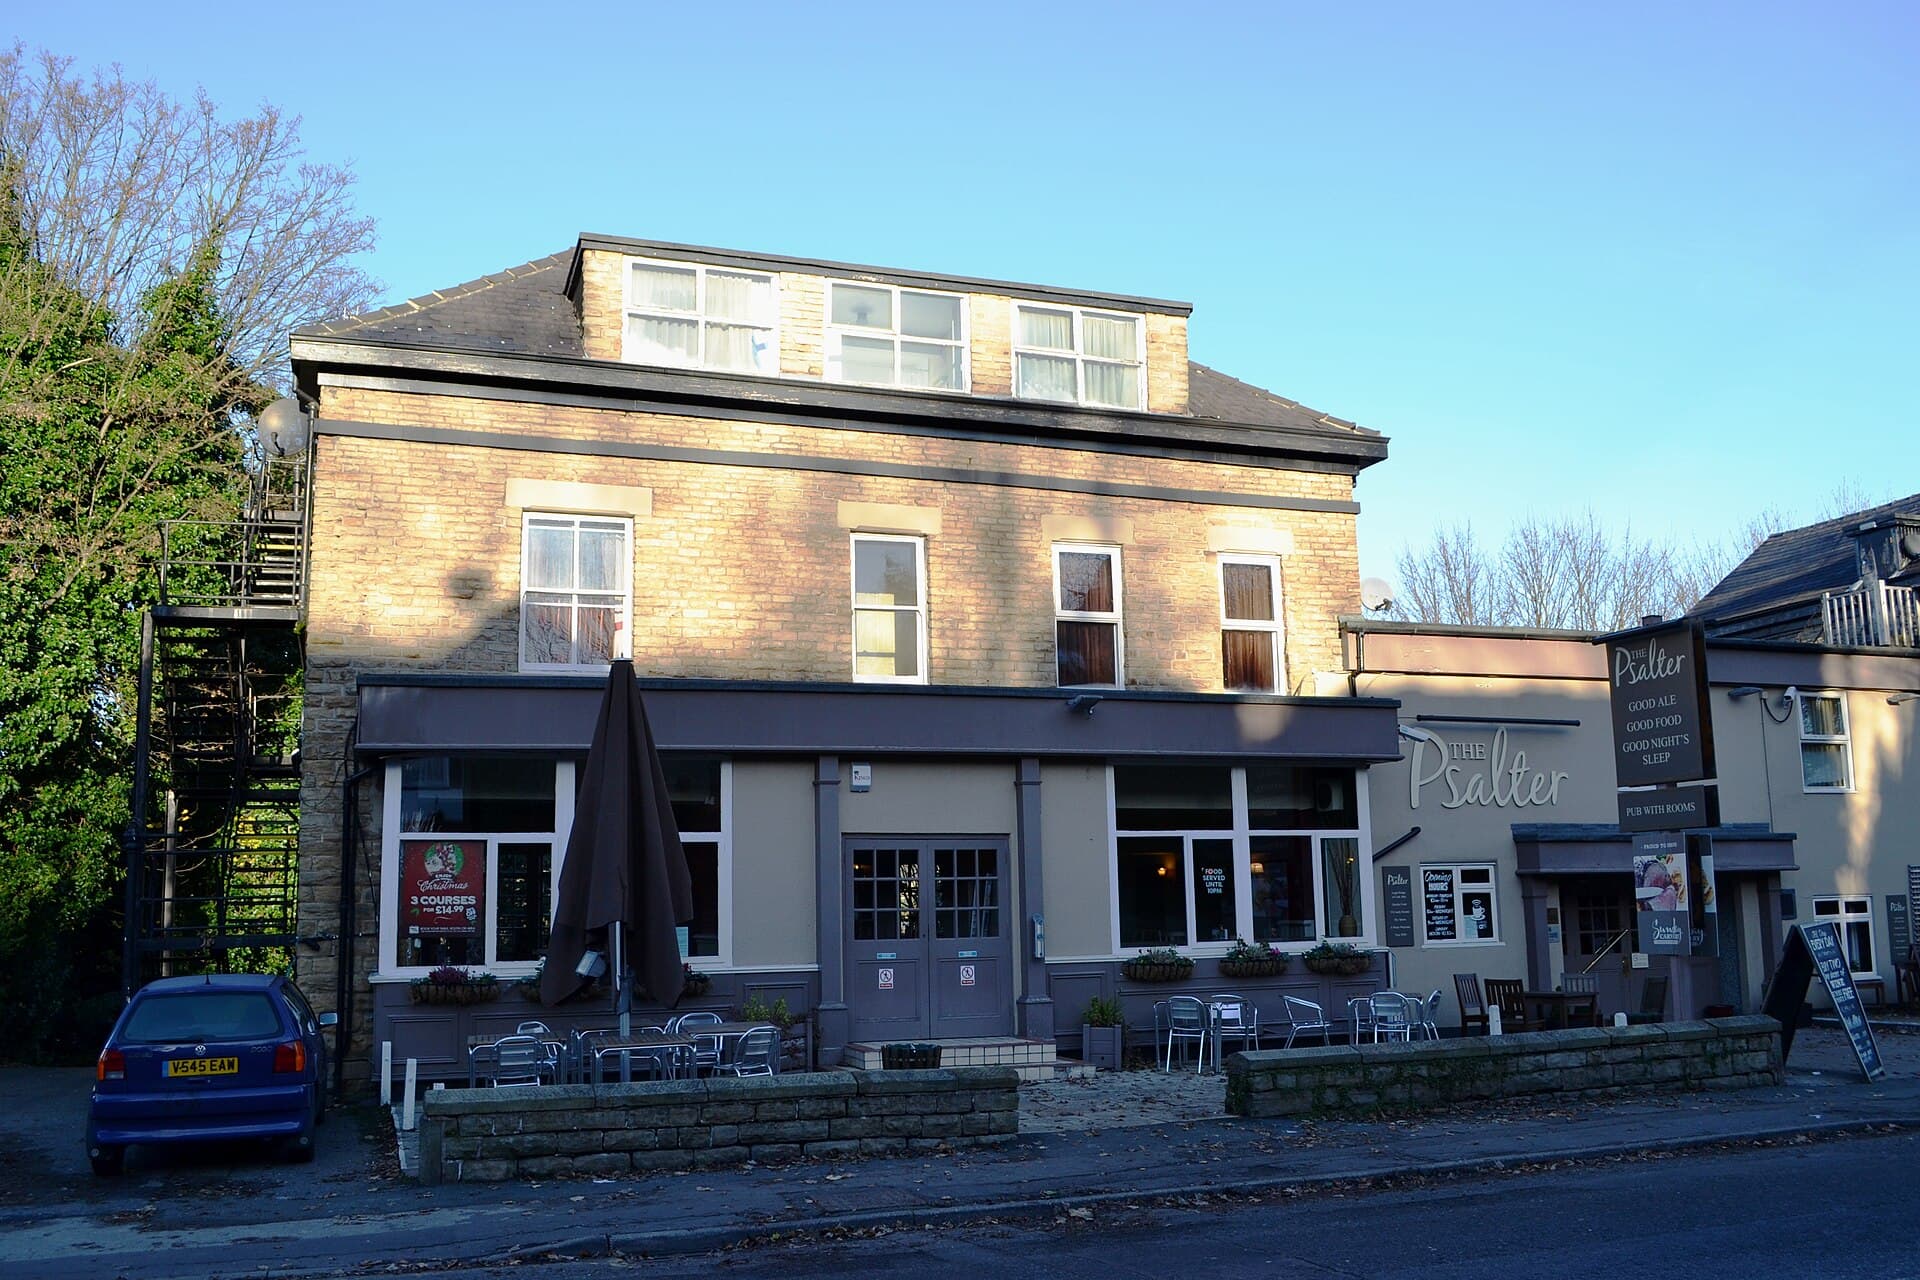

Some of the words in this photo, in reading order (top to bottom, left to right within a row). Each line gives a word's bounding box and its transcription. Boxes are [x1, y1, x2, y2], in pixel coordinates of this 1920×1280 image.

[1630, 649, 1647, 659] THE
[1614, 638, 1685, 688] Psalter
[1628, 699, 1656, 712] GOOD
[1657, 694, 1677, 707] ALE
[1626, 719, 1654, 732] GOOD
[1655, 714, 1682, 728] FOOD
[1448, 743, 1486, 760] THE
[1622, 739, 1650, 753] GOOD
[1650, 733, 1690, 750] NIGHT'S
[1642, 751, 1671, 766] SLEEP
[1410, 726, 1569, 809] Psalter
[1626, 805, 1642, 817] PUB
[1643, 803, 1665, 815] WITH
[1666, 801, 1696, 814] ROOMS
[417, 879, 469, 892] Christmas
[410, 896, 419, 905] 3
[420, 896, 477, 905] COURSES
[435, 905, 464, 915] £14.99
[172, 1060, 207, 1074] V545
[209, 1057, 236, 1072] EAW
